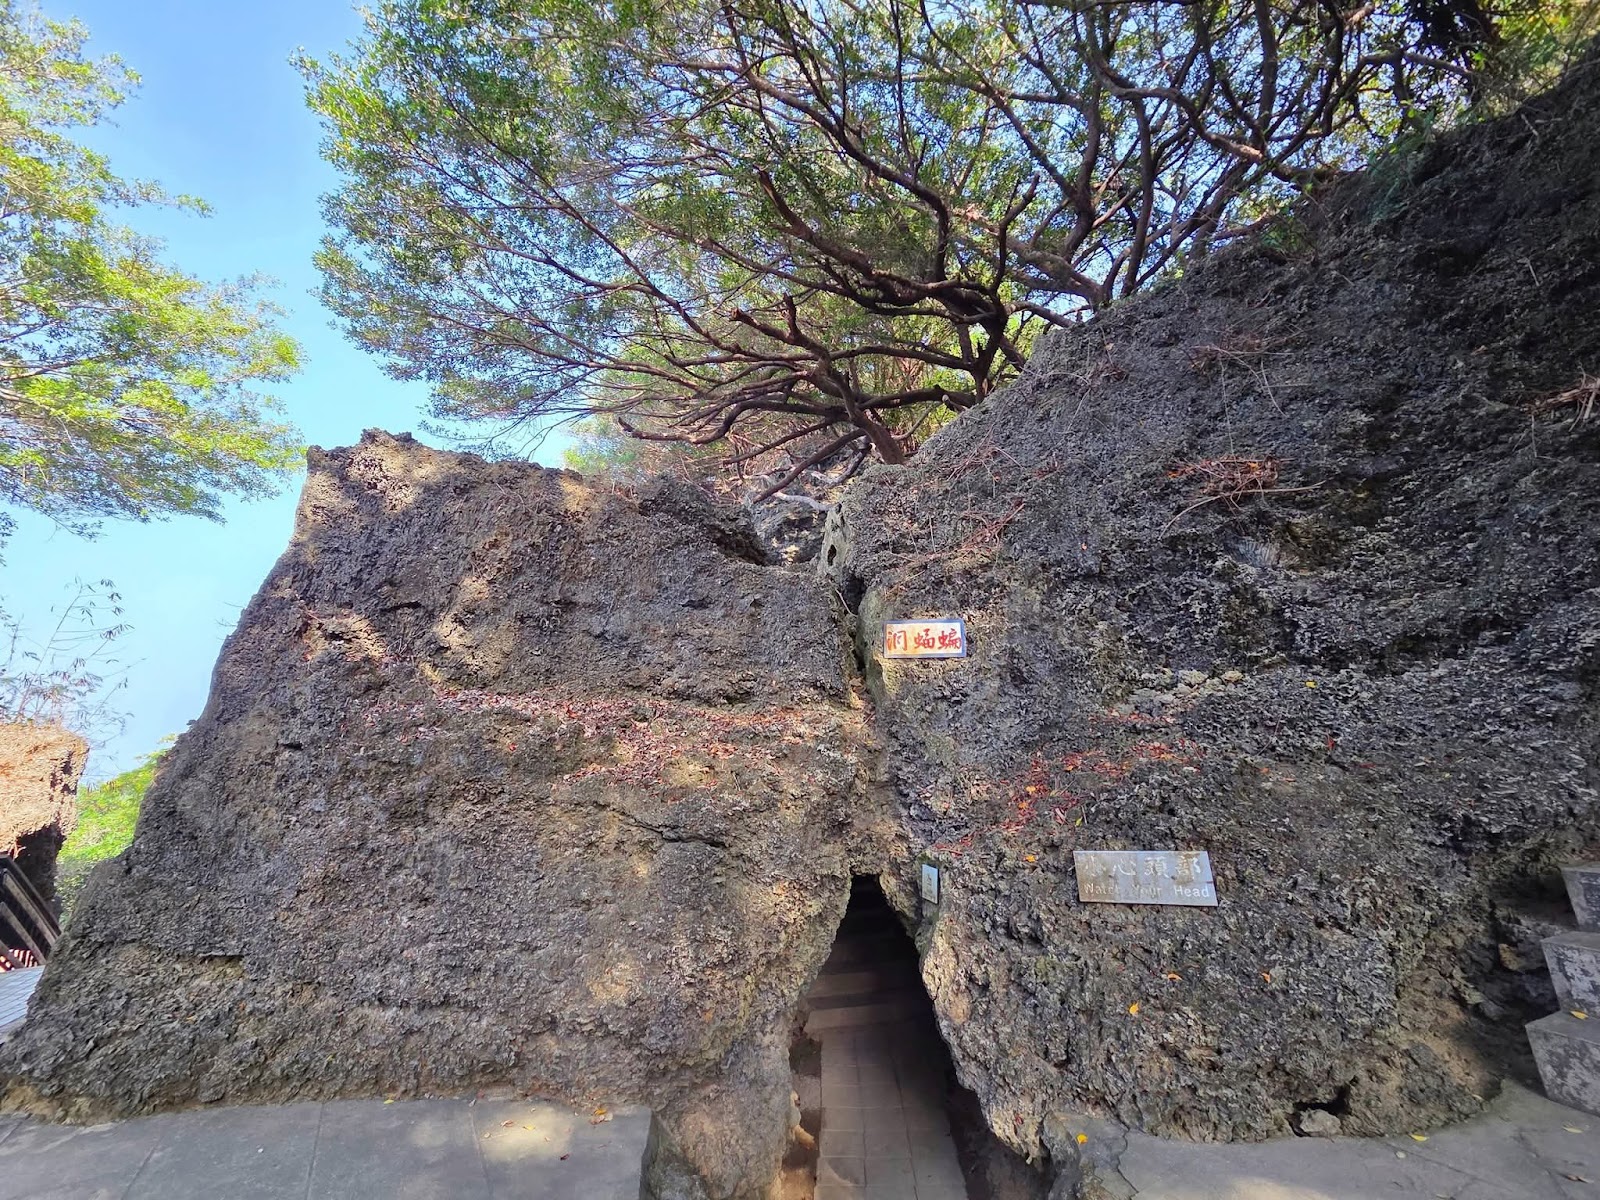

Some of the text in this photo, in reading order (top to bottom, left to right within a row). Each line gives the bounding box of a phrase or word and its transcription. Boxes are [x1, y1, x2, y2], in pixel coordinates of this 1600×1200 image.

[1084, 854, 1201, 881] 小心頭部
[1131, 884, 1162, 898] Your
[1174, 885, 1209, 898] Head
